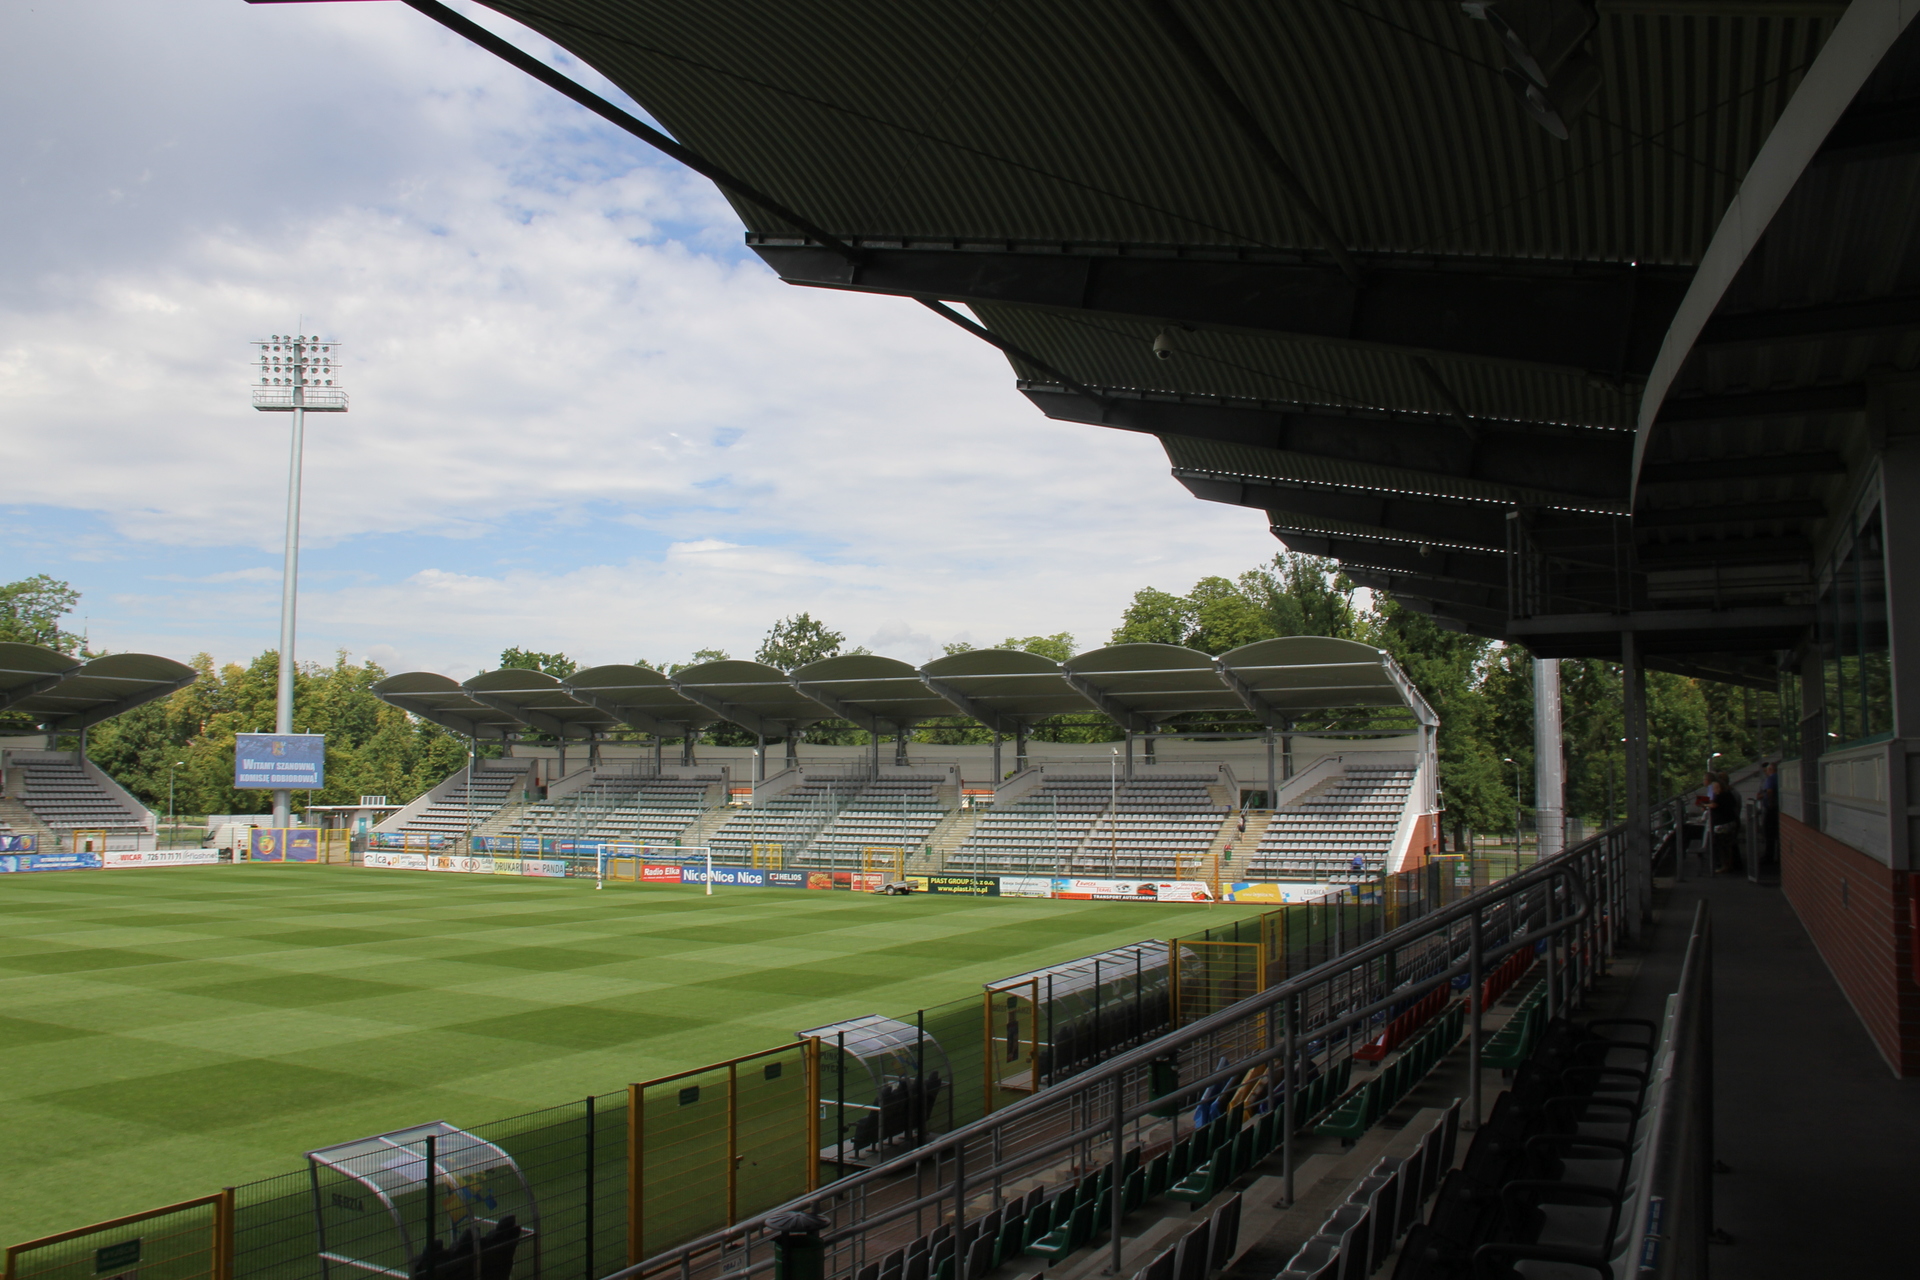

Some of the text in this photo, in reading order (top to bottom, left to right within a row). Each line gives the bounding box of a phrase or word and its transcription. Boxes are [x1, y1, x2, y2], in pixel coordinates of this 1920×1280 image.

[147, 853, 159, 861] 726
[431, 858, 456, 868] LPGK
[542, 864, 563, 873] PANDA
[644, 867, 680, 876] Radio Elka
[737, 871, 762, 884] Nice
[779, 873, 802, 881] HELIOS
[930, 877, 947, 885] PIAST
[948, 878, 969, 886] GROUP
